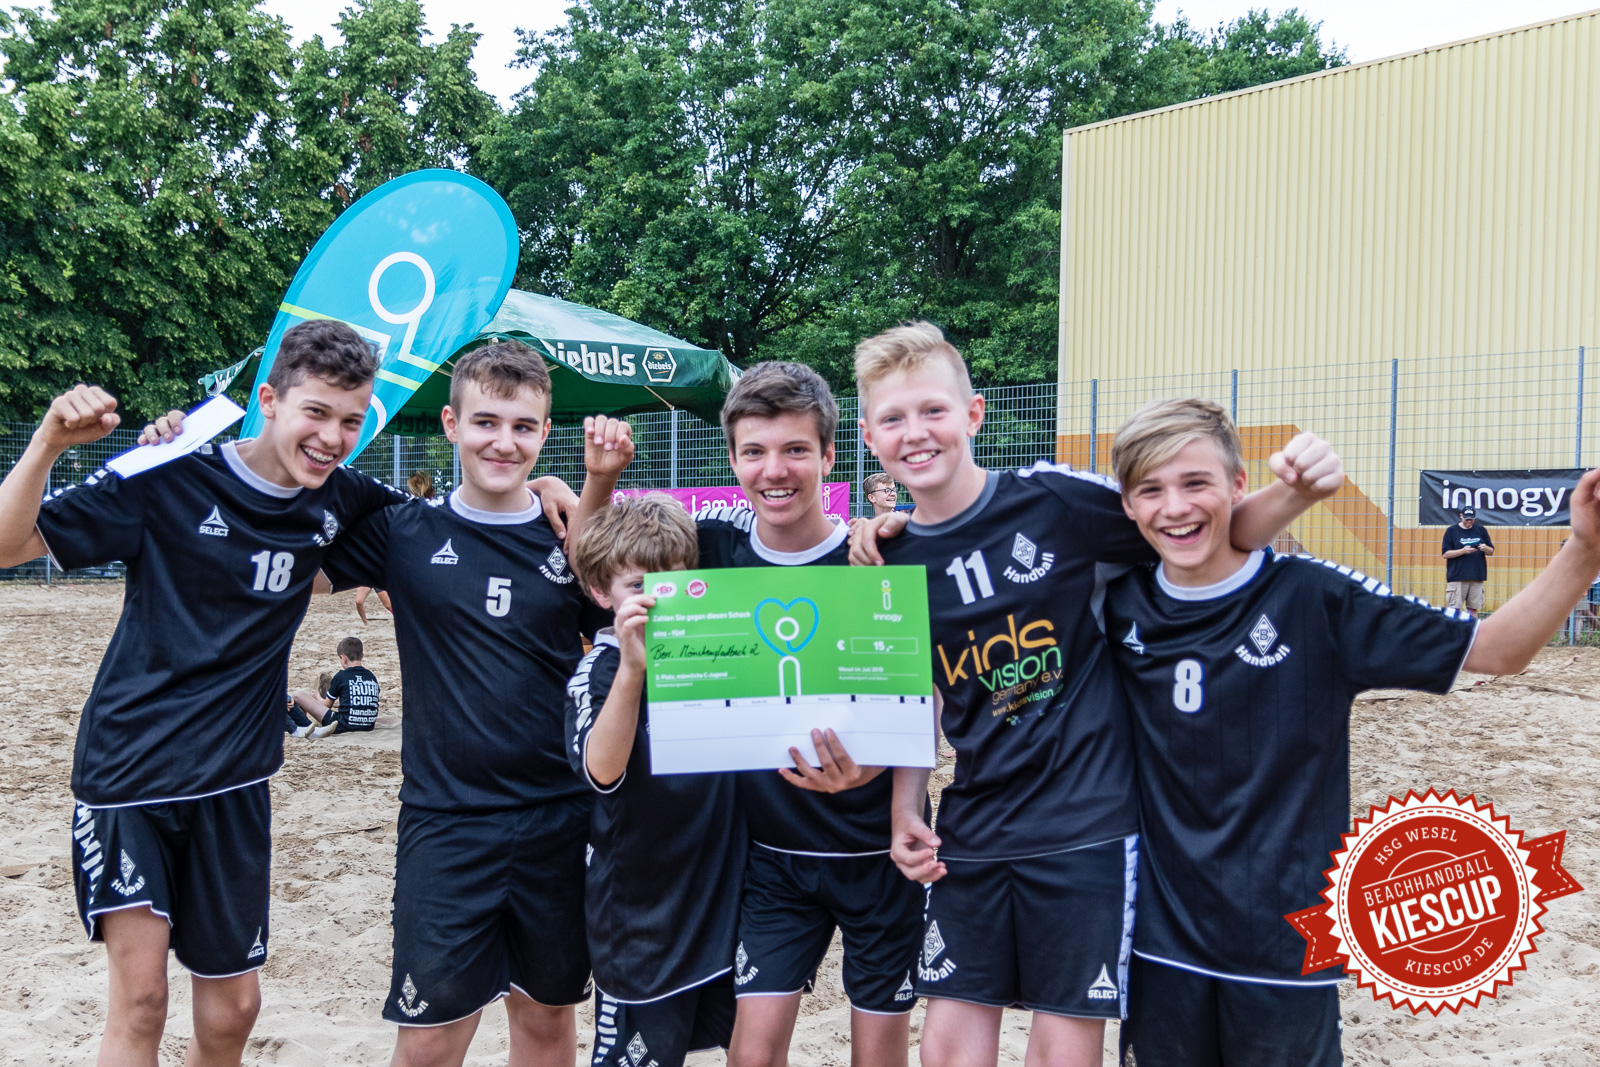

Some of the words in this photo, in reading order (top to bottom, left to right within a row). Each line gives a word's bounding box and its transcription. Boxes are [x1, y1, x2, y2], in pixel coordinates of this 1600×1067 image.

[647, 360, 672, 371] Diebels
[1442, 479, 1566, 517] innogy
[199, 525, 229, 537] SELECT
[251, 550, 295, 592] 18
[430, 556, 459, 565] SELECT
[1003, 552, 1055, 584] Handball
[945, 550, 995, 605] 11
[485, 576, 512, 618] 5
[652, 614, 674, 622] Zahlen
[675, 613, 686, 621] Sie
[686, 612, 706, 623] gegen
[707, 611, 728, 620] diesen
[728, 610, 751, 619] Scheck
[873, 612, 903, 622] innogy
[937, 614, 1058, 686] kids
[1235, 644, 1291, 667] Handball
[978, 646, 1062, 692] vision
[1172, 658, 1203, 713] 8
[353, 696, 372, 706] CUP
[1088, 990, 1118, 999] SELECT
